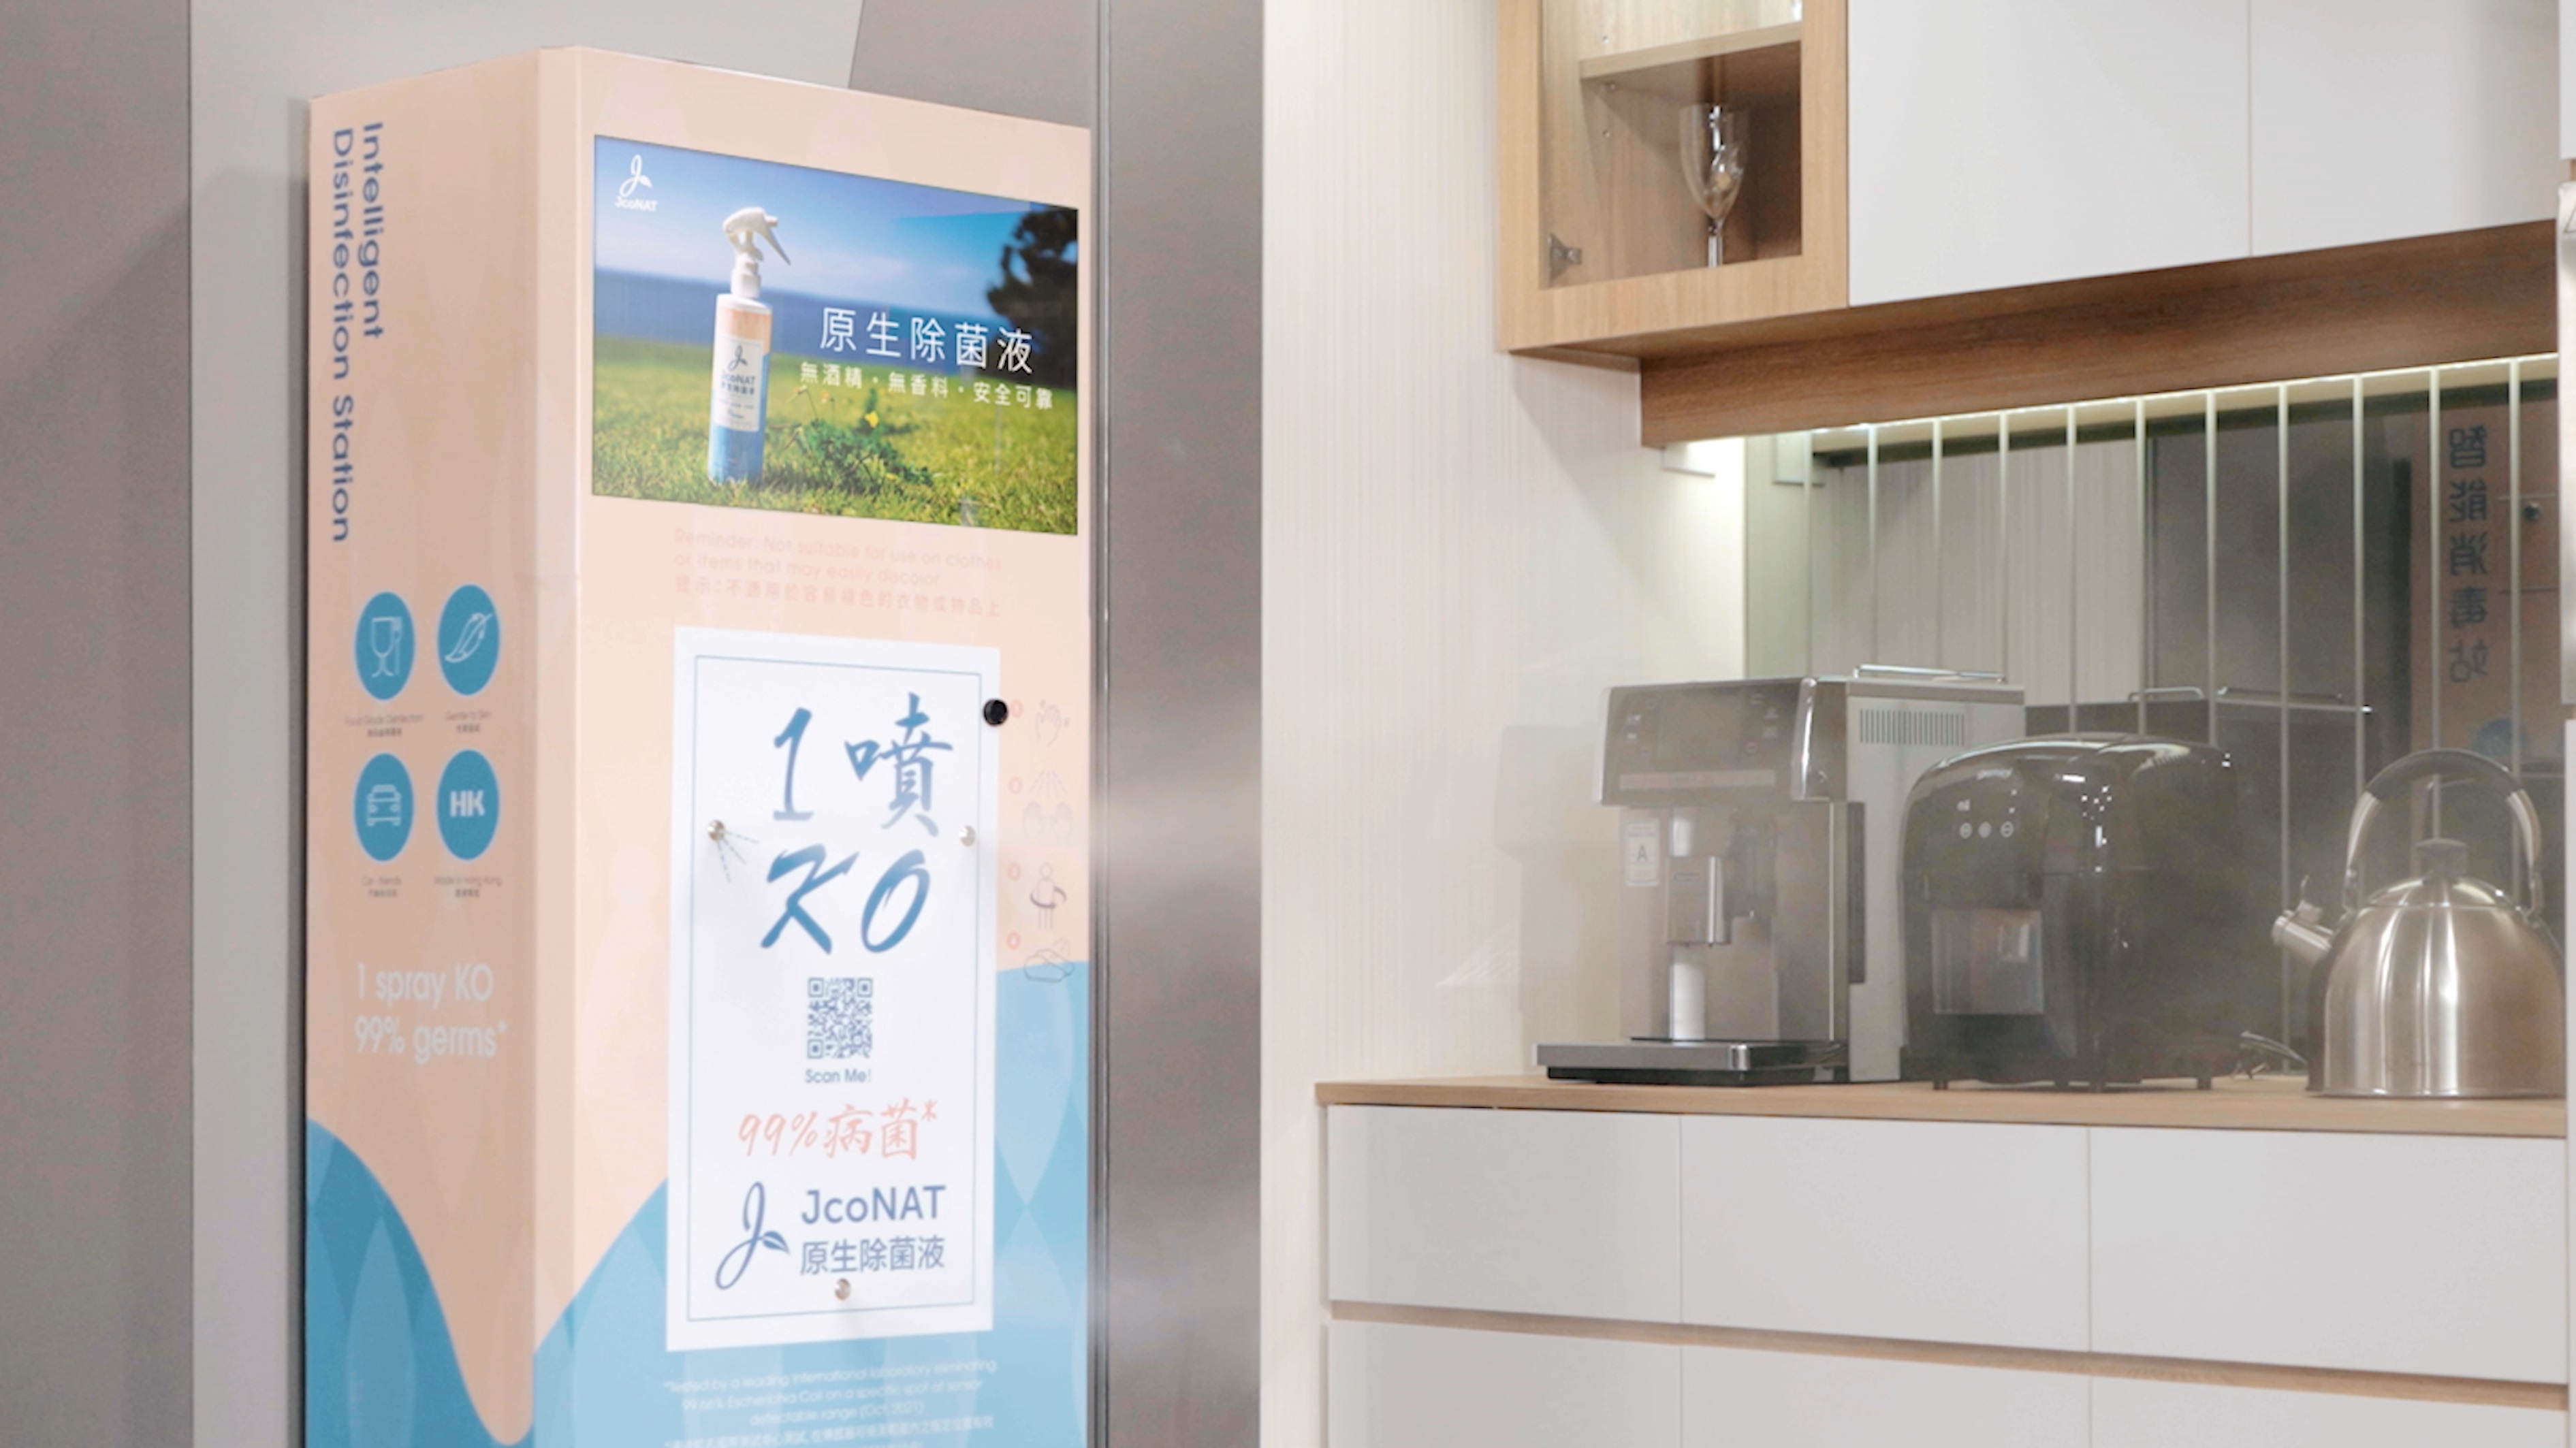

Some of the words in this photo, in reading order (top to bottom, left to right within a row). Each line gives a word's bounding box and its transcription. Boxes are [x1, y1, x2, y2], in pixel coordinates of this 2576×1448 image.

[357, 123, 384, 338] Intelligent
[333, 128, 354, 380] Disinfection
[820, 307, 1033, 374] 原生除菌液
[333, 395, 354, 541] Station
[697, 555, 742, 570] items
[747, 558, 780, 573] that
[788, 563, 821, 579] may
[865, 545, 885, 560] for
[891, 550, 916, 563] use
[921, 552, 942, 565] on
[947, 553, 1002, 571] clothes
[450, 790, 486, 817] HK
[761, 843, 930, 954] KO
[357, 961, 366, 999] 1
[376, 971, 446, 1009] spray
[454, 963, 494, 1002] KO
[354, 1015, 405, 1053] 99%
[805, 1068, 841, 1083] Scan
[844, 1067, 872, 1083] Me!
[801, 1185, 946, 1225] JcoNAT
[800, 1235, 945, 1276] 原生除菌液
